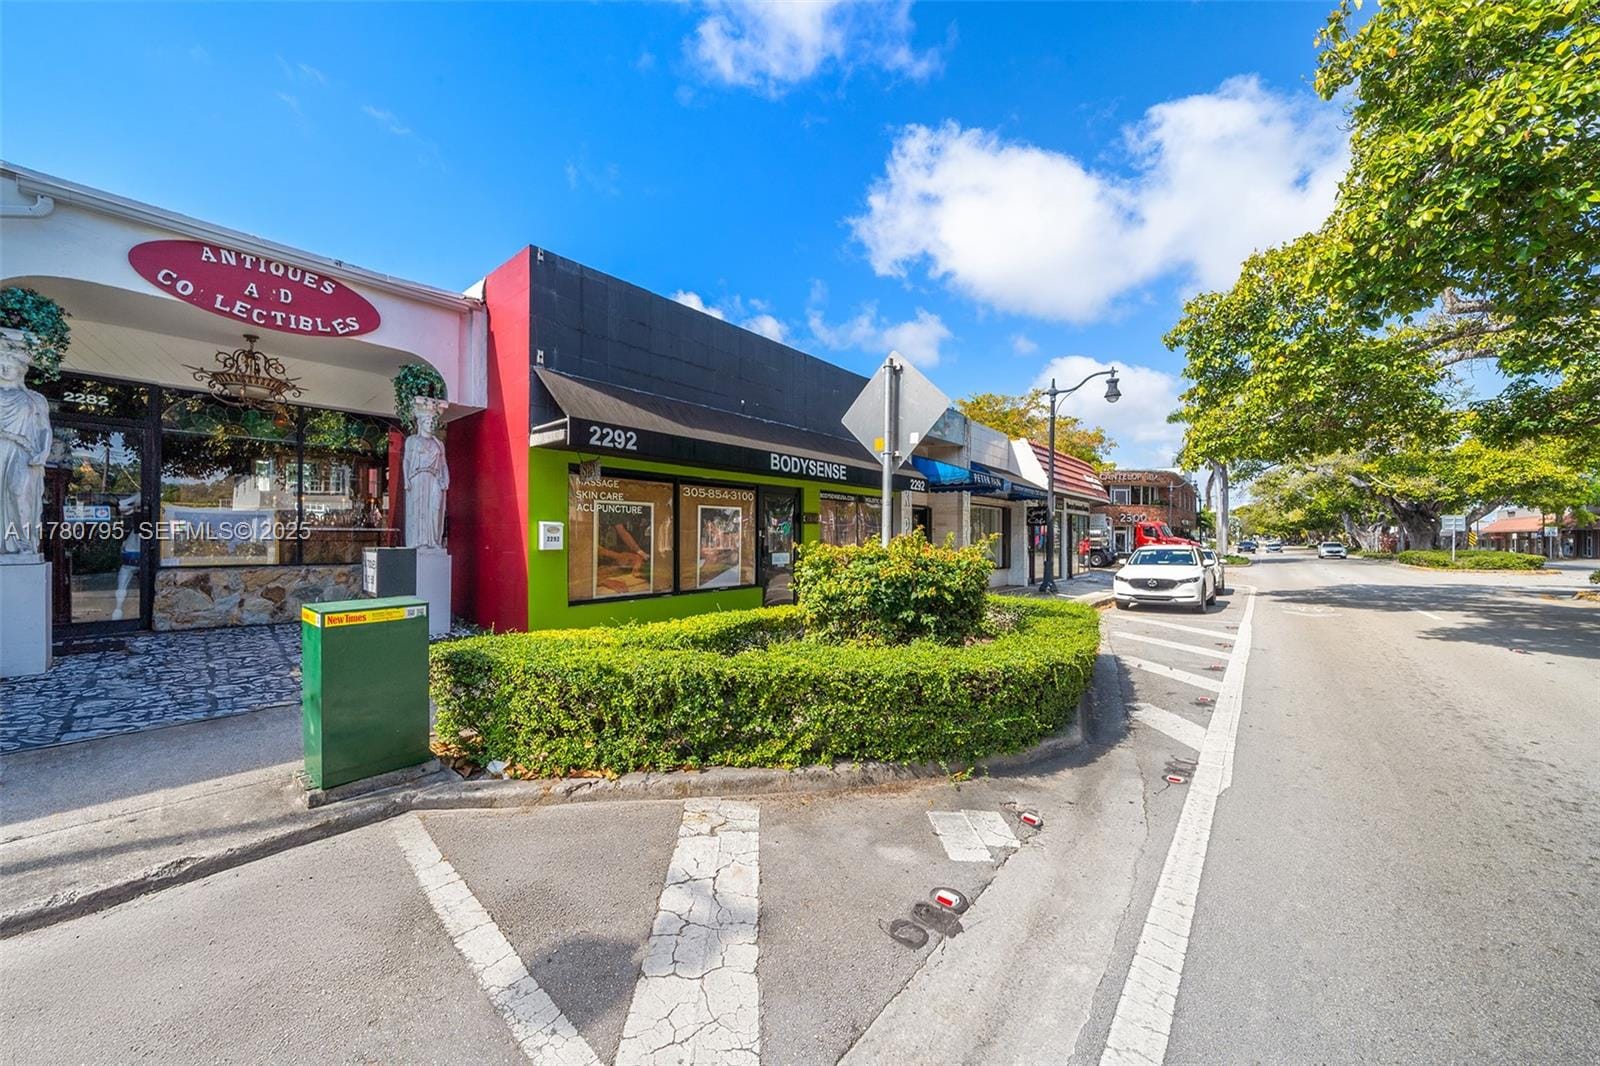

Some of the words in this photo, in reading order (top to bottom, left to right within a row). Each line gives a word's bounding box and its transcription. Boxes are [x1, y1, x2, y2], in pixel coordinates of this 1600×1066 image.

[201, 246, 336, 295] ANTIQUES
[244, 282, 293, 304] AD
[156, 268, 360, 335] COLECTIBLES
[63, 391, 109, 406] 2282
[589, 425, 638, 450] 2292
[770, 453, 847, 481] BODYSENSE
[576, 477, 620, 489] MASSAGE
[910, 478, 925, 491] 2292
[576, 490, 598, 500] SKIN
[600, 491, 624, 501] CARE
[683, 487, 754, 501] 305-854-3100
[576, 503, 643, 514] ACUPUNCTURE
[1120, 513, 1147, 523] 2500
[327, 614, 345, 625] New
[345, 613, 367, 624] Times
